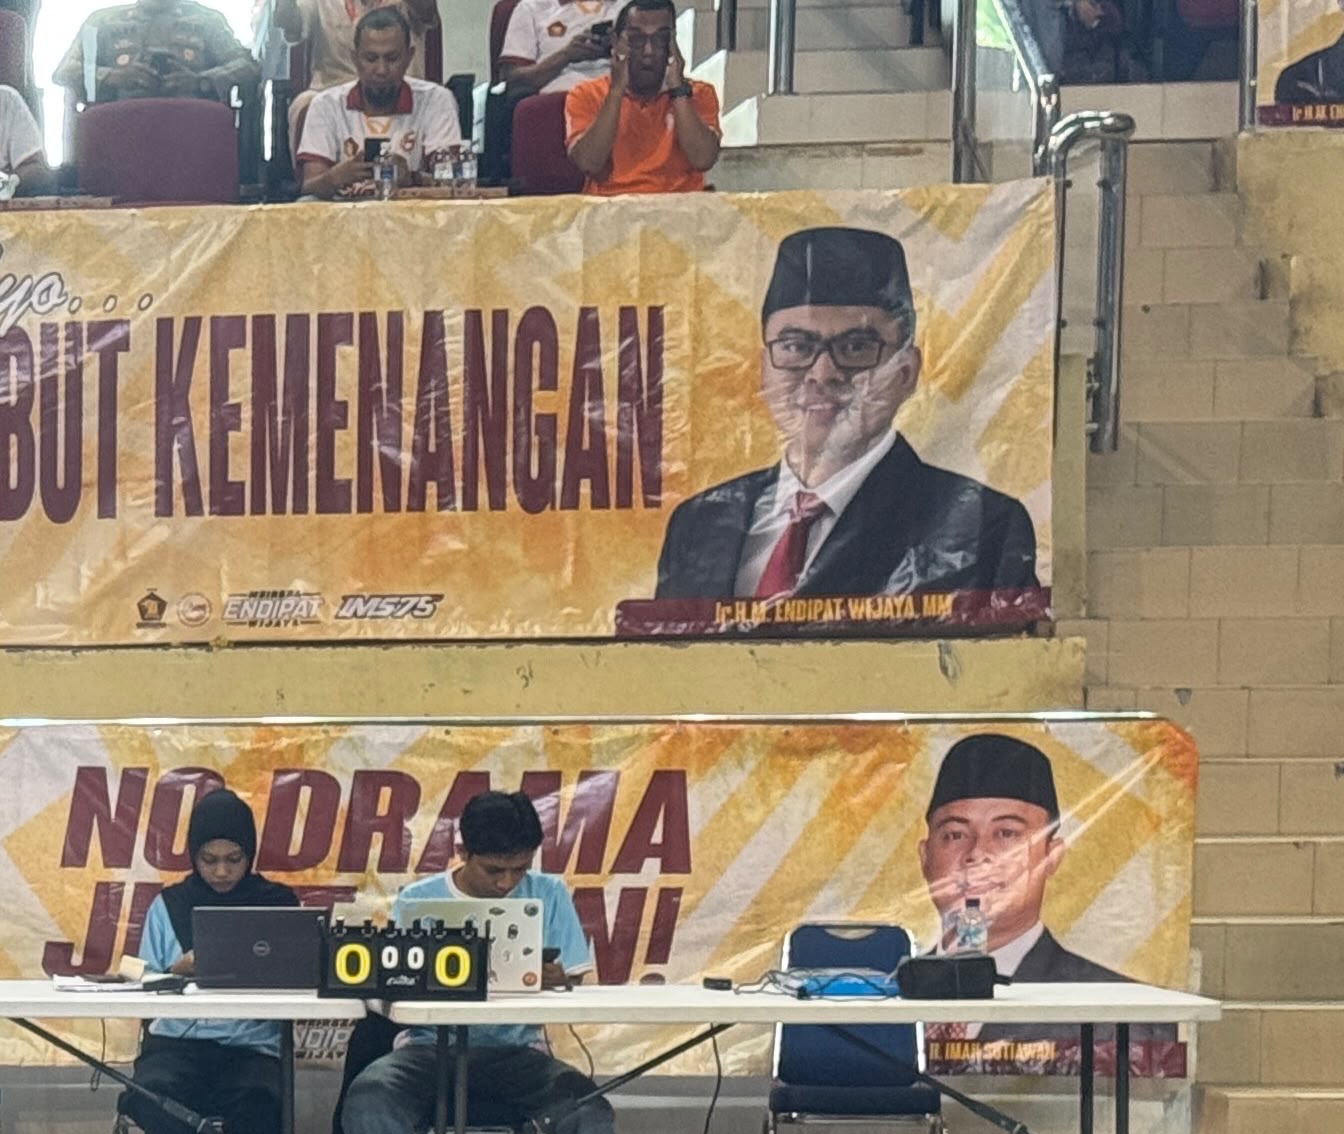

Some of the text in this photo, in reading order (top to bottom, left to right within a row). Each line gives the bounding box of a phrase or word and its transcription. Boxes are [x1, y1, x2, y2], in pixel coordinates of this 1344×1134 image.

[155, 304, 666, 518] KEMENANGAN
[224, 598, 324, 620] ENDIPAT
[775, 597, 844, 622] ENDIPAT
[335, 943, 371, 985] 0
[434, 945, 471, 987] 0
